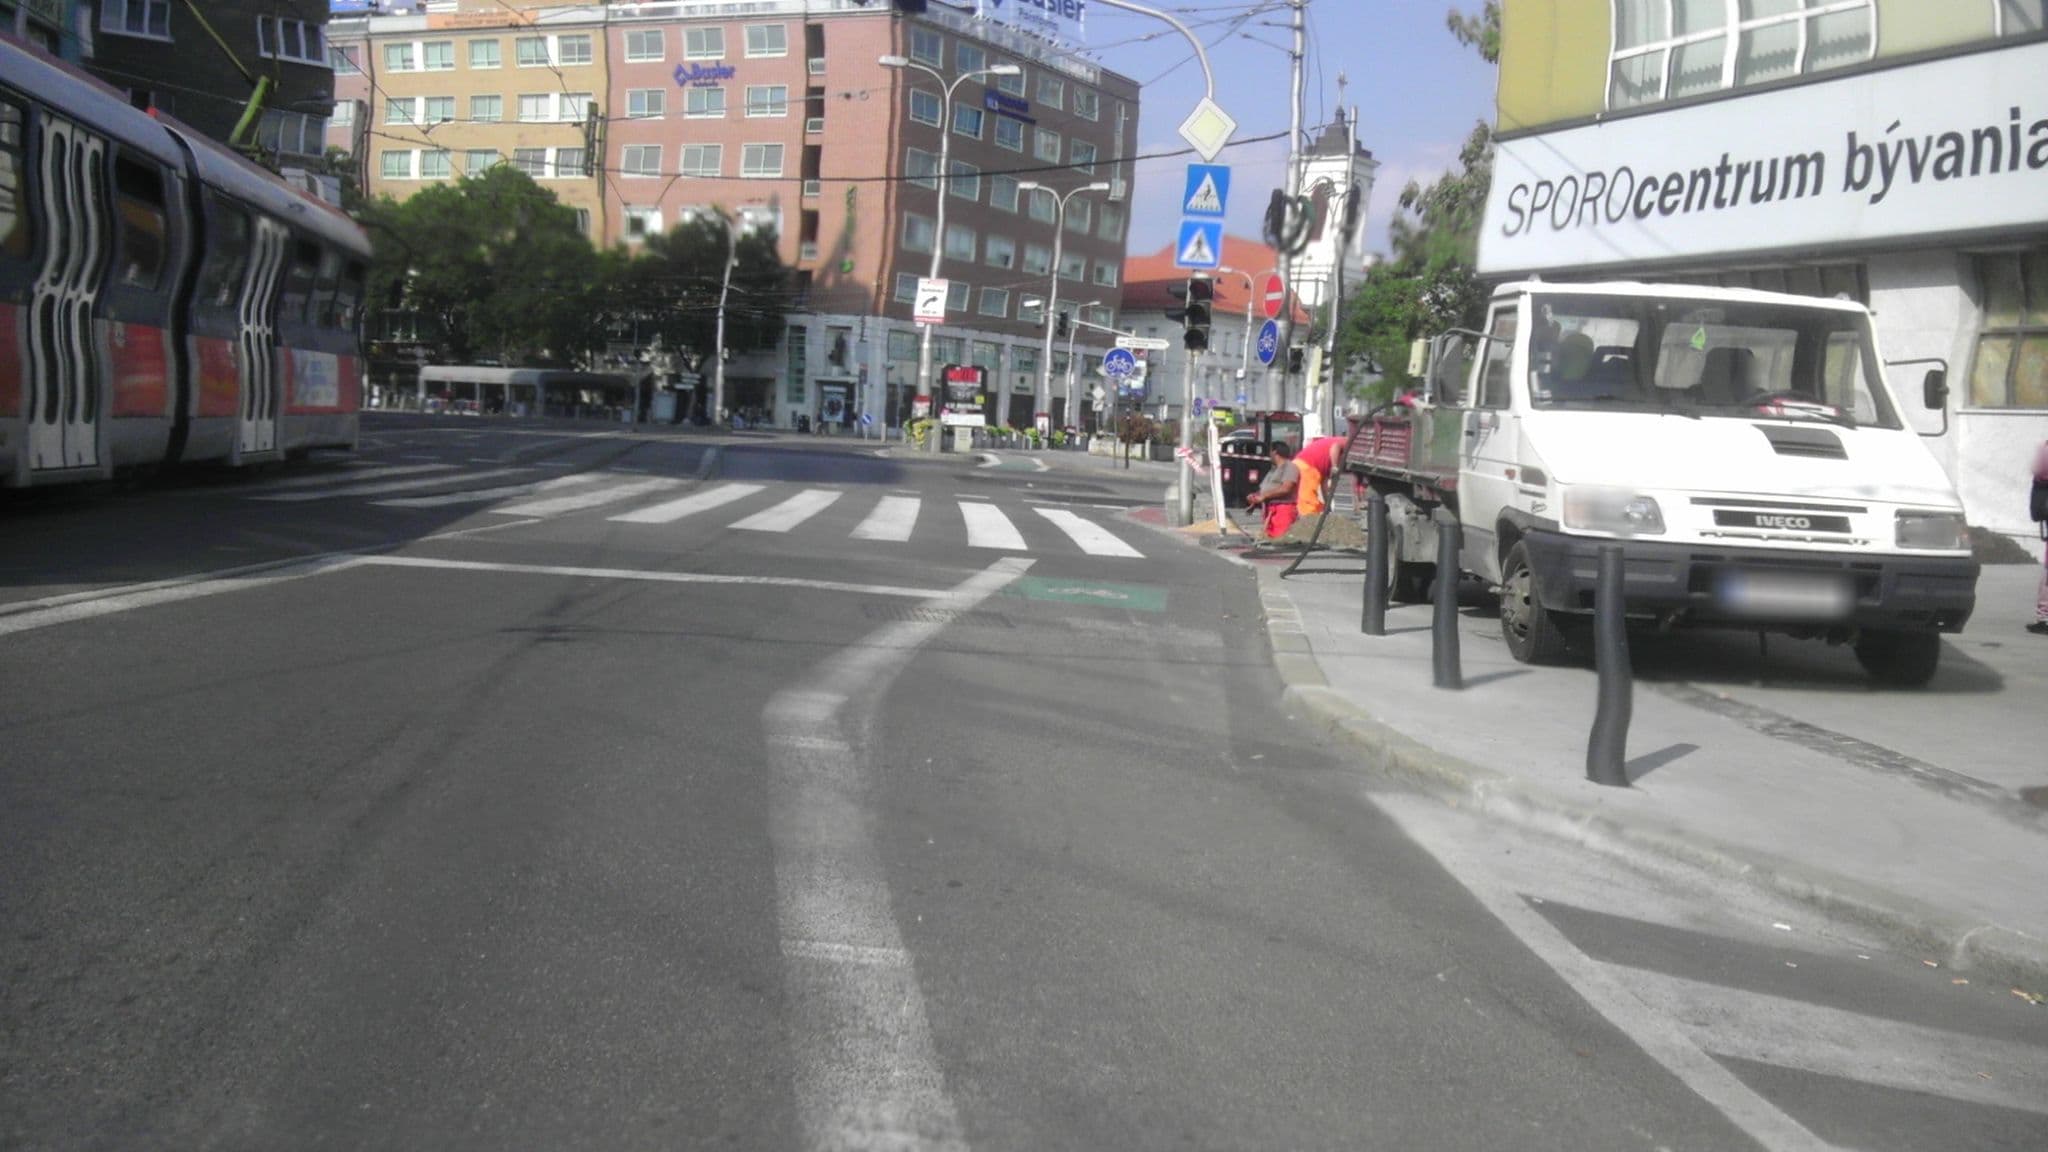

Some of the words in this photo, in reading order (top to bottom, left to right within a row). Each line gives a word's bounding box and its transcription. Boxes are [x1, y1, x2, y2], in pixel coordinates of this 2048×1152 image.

[1015, 0, 1085, 20] asler
[1502, 151, 1826, 238] SPOROcentrum
[1755, 515, 1810, 528] IVECO
